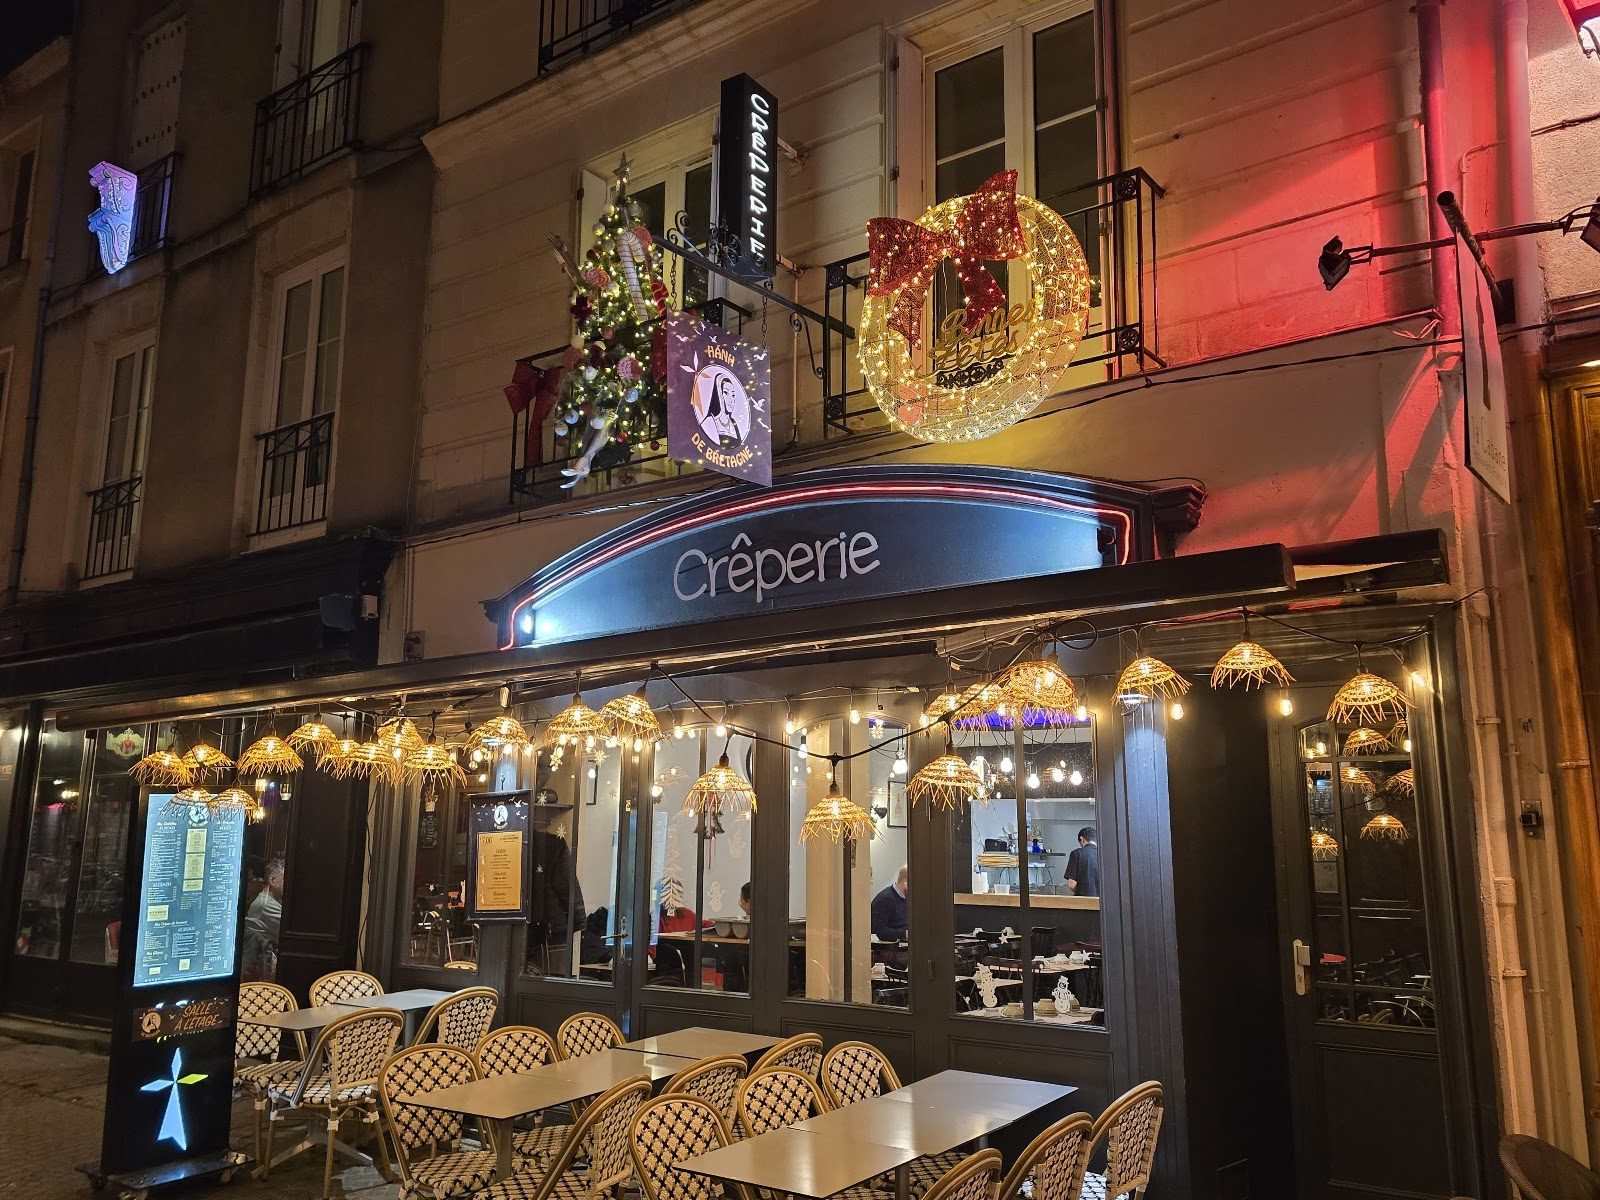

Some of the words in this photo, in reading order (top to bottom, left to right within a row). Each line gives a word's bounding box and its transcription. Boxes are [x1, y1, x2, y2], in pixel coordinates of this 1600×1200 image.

[941, 299, 1036, 345] Bnnes
[691, 432, 706, 453] DE
[705, 445, 754, 468] BRETAGNE
[673, 531, 881, 603] Crêperie
[182, 1002, 214, 1018] SALLE
